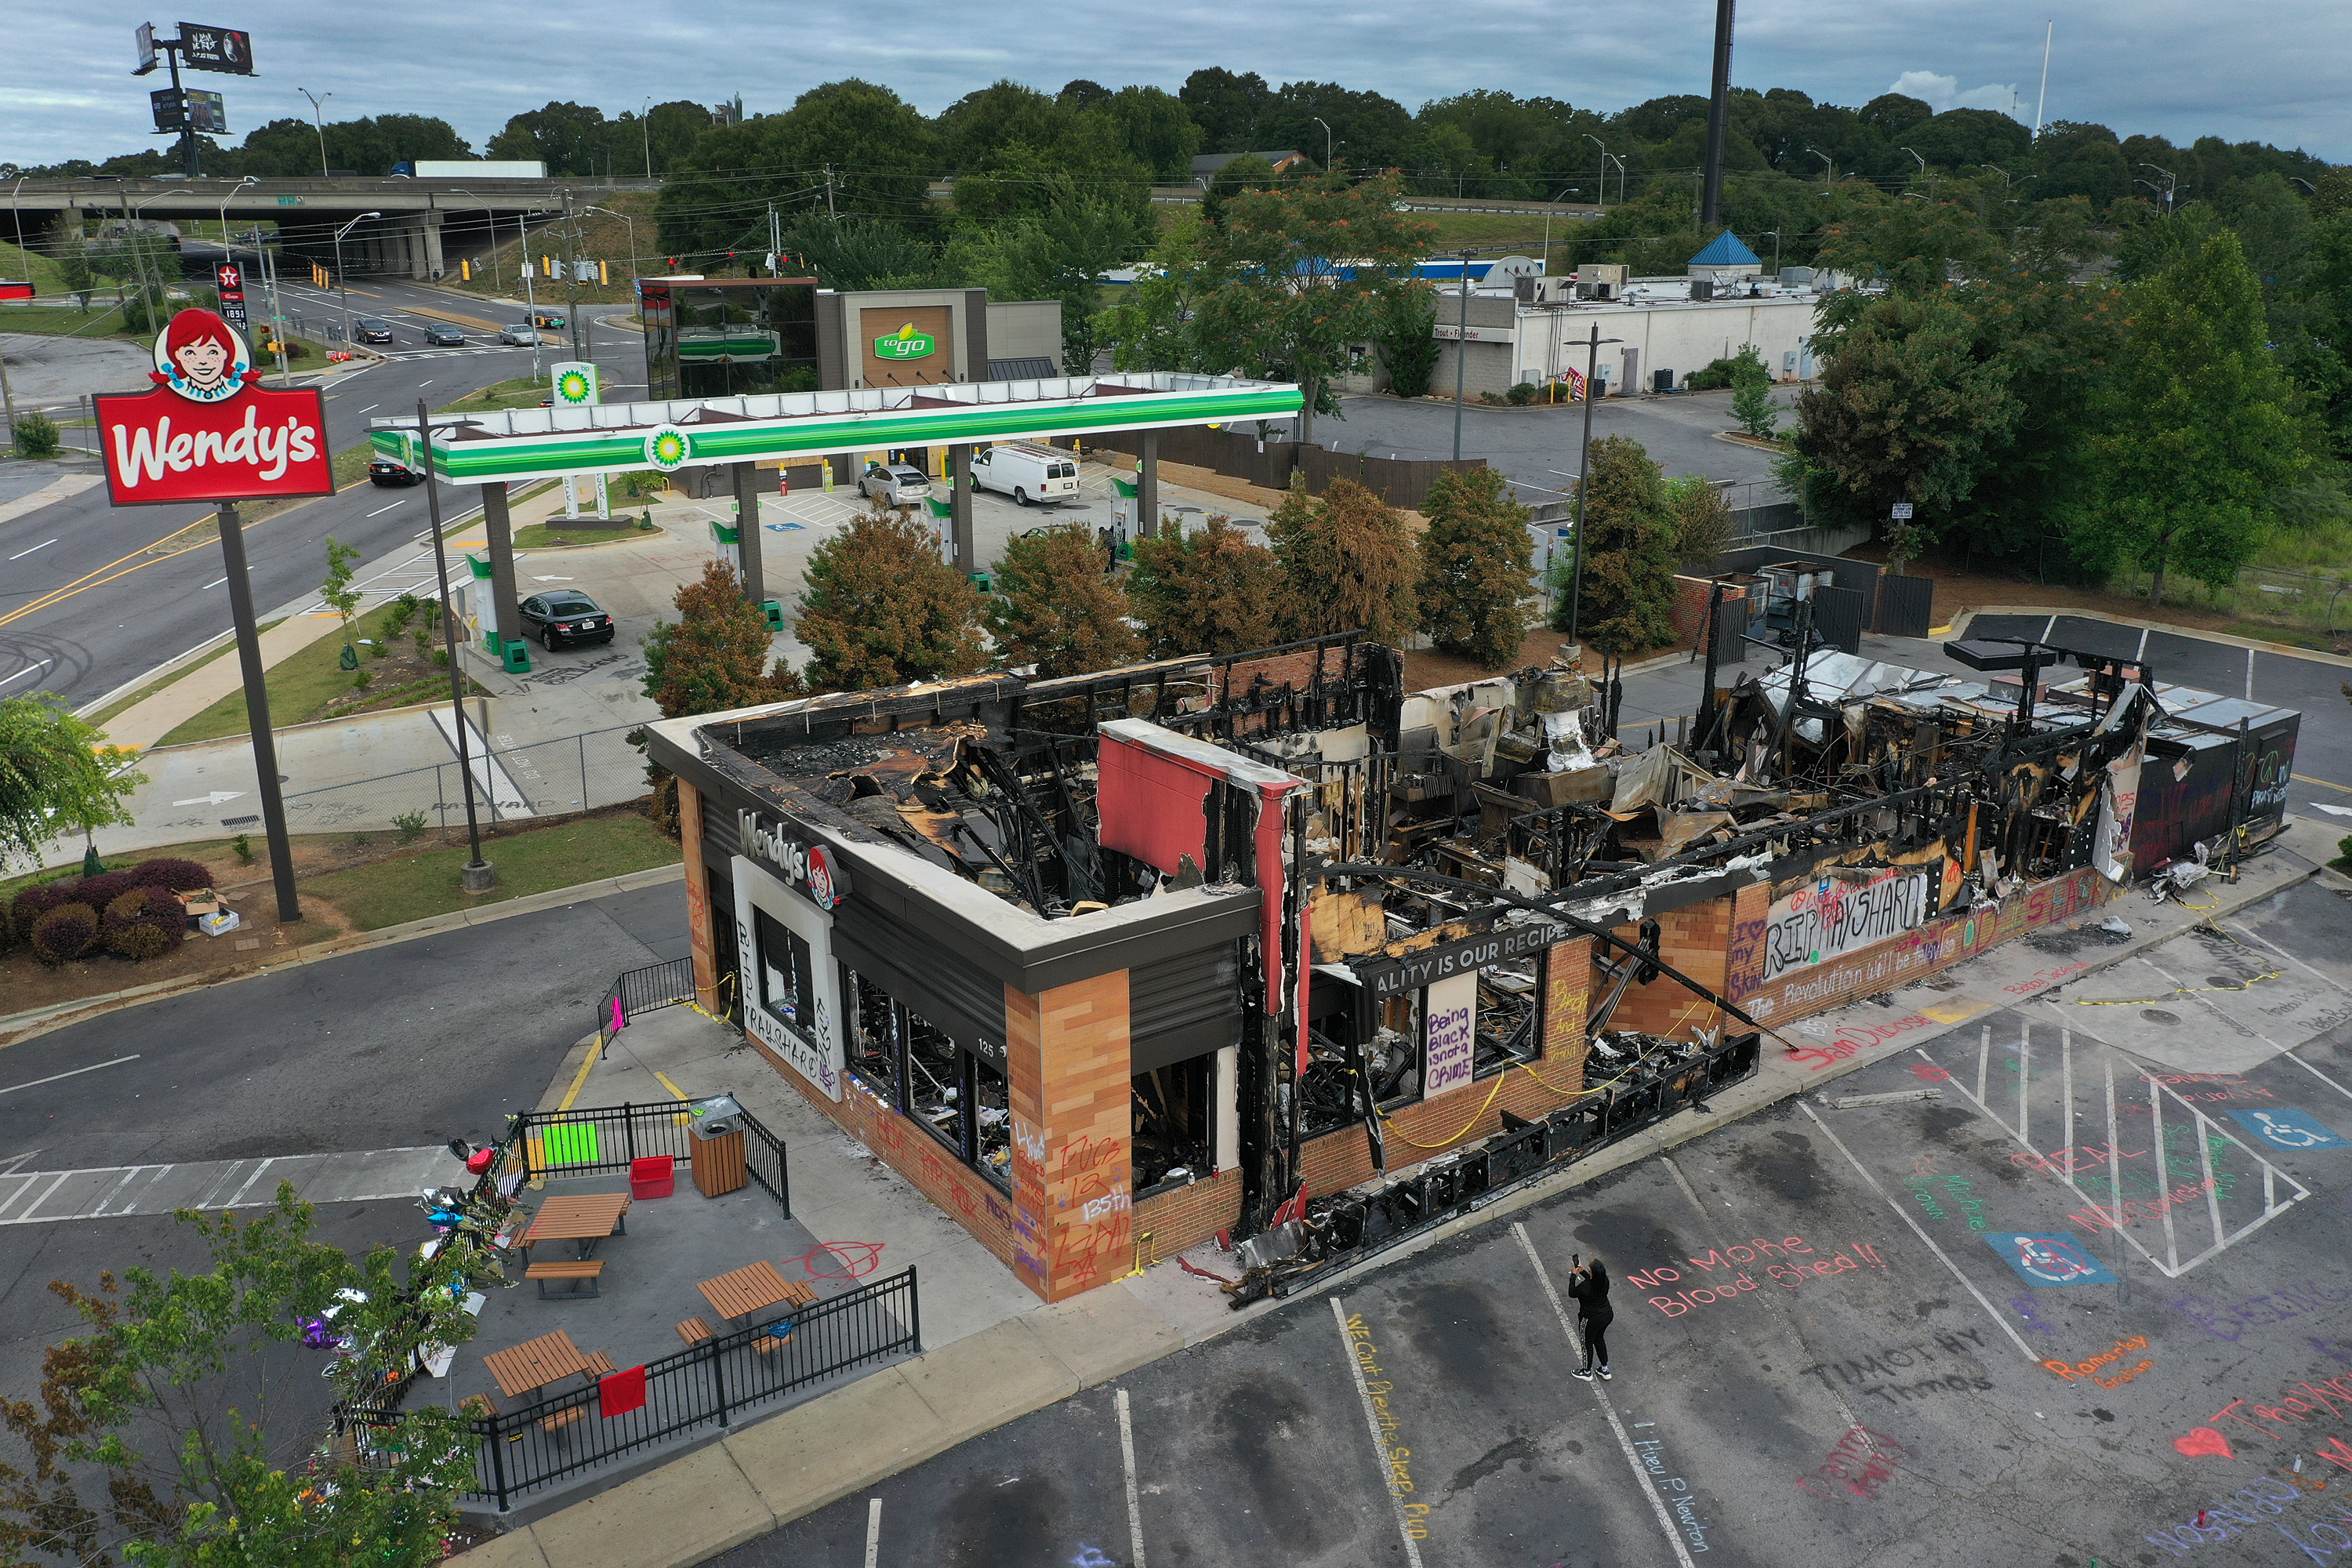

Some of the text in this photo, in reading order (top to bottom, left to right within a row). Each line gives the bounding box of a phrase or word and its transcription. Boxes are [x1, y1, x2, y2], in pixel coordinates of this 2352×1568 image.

[1435, 328, 1479, 339] Trout Flnder
[111, 405, 316, 488] Wendy's
[651, 550, 716, 563] BLM
[737, 808, 804, 887] Wendy's
[1763, 909, 1818, 980] RIP
[1818, 875, 1920, 951] RAYSHARD
[1438, 955, 1454, 975] IS
[1460, 943, 1498, 967] OUR
[1732, 945, 1755, 965] my
[1747, 997, 1776, 1021] The
[1784, 965, 1862, 1007] Revolution
[1896, 950, 1910, 971] be
[2003, 961, 2096, 995] Bobby Jackson
[1428, 1007, 1469, 1036] Being
[978, 1037, 994, 1058] 125
[2010, 1142, 2147, 1175] REAL
[1083, 1184, 1133, 1221] 135th
[1902, 1177, 1950, 1221] Brown
[1944, 1175, 2005, 1234] Michael
[1649, 1272, 1758, 1317] Blood
[1347, 1313, 1370, 1341] WE
[1801, 1328, 1984, 1385] TIMOTHY
[2042, 1334, 2148, 1382] Ramarley
[2092, 1359, 2154, 1390] Graham
[1635, 1440, 1666, 1475] Huey
[1672, 1495, 1708, 1552] Newton
